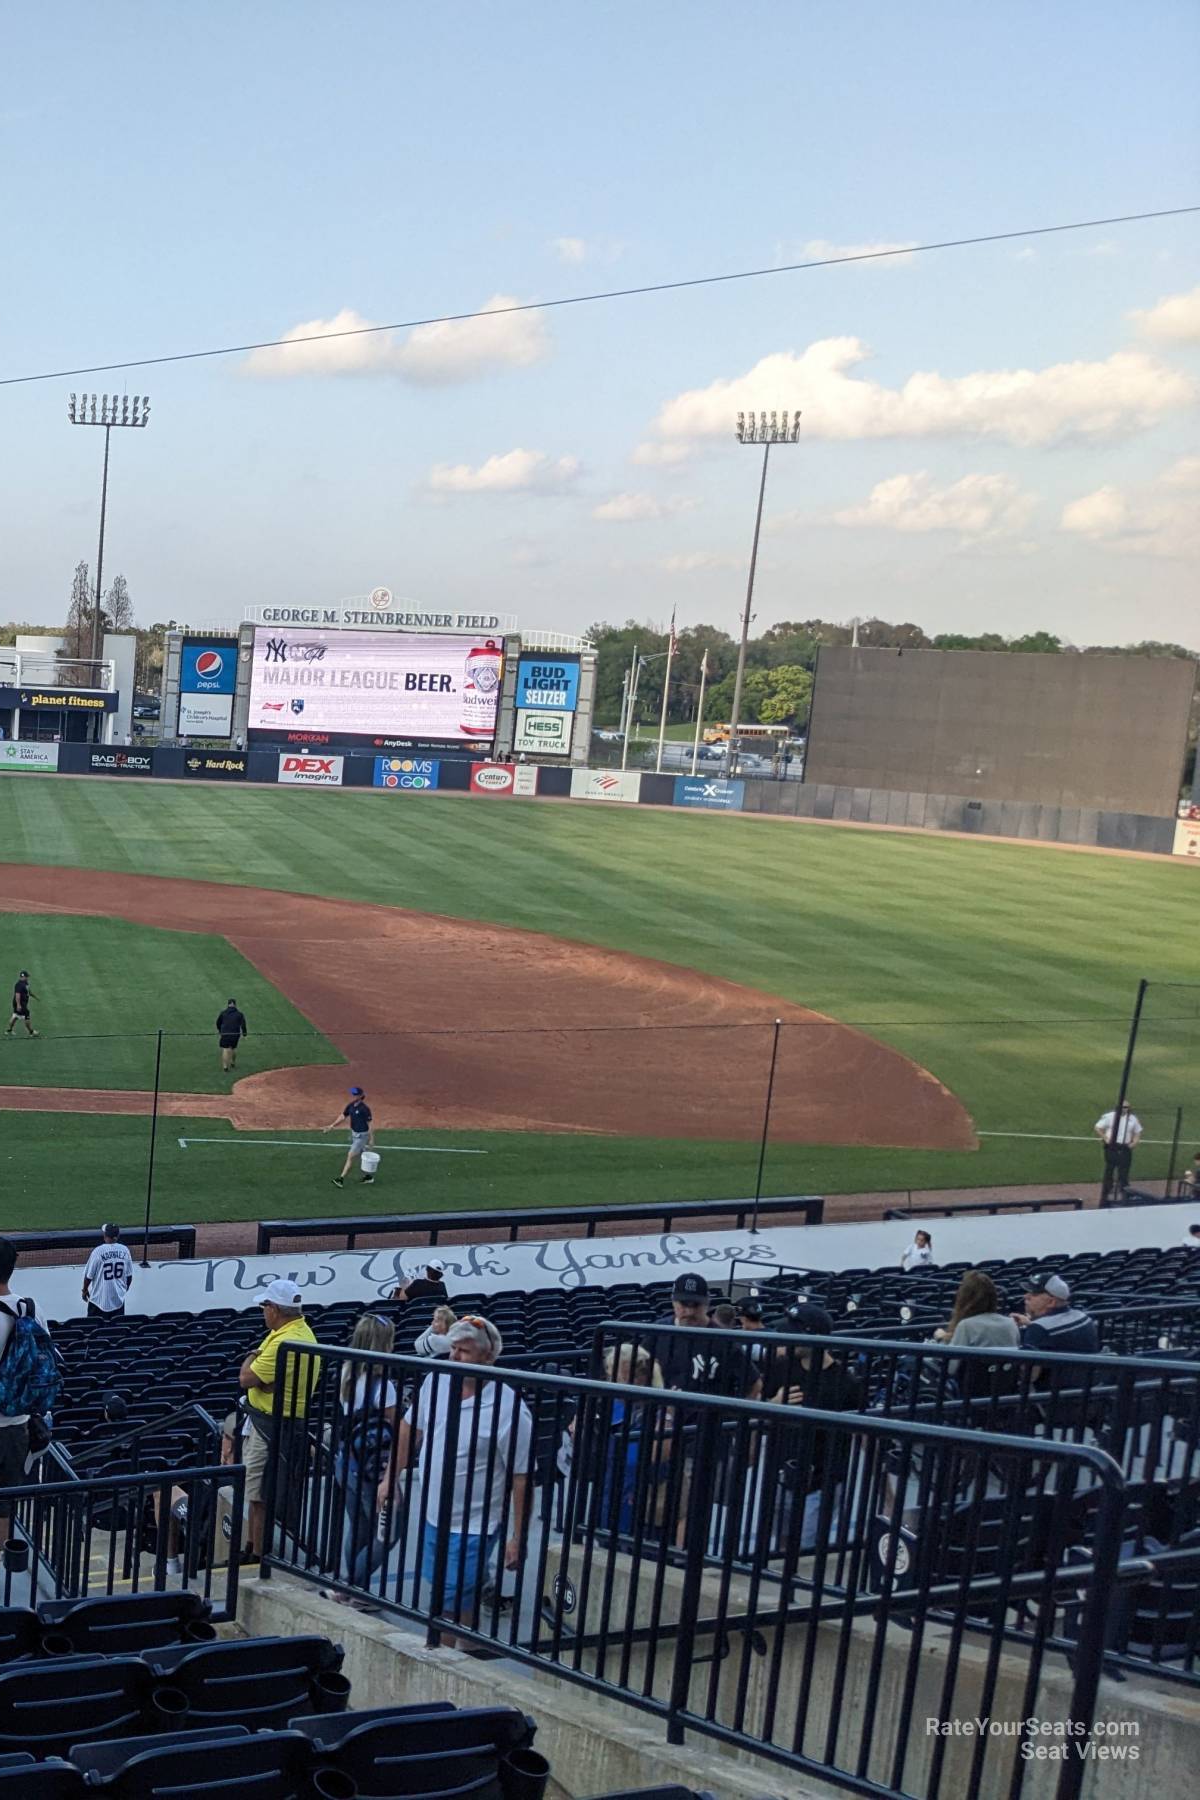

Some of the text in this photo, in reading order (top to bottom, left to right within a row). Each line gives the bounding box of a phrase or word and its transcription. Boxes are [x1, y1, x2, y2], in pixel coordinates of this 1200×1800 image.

[262, 607, 499, 629] GEORGE M. STEINBRENNER FIELD
[531, 665, 566, 679] BUD
[196, 681, 220, 690] pepsi
[263, 666, 457, 693] MAJOR LEAGUE BEER.
[523, 678, 571, 691] LIGHT
[31, 694, 104, 708] planet fitness
[525, 690, 566, 705] SELTZER
[528, 722, 560, 732] HESS
[384, 739, 412, 748] AnyDesk
[538, 740, 566, 748] TRUCK
[91, 754, 150, 765] BAD BOY
[205, 759, 225, 769] Hard
[225, 760, 244, 771] Rock
[283, 757, 335, 773] DEX
[382, 759, 432, 774] ROOMS
[294, 772, 339, 782] imaging
[381, 775, 424, 789] TO GO
[477, 772, 509, 784] Century
[158, 1258, 336, 1293] New
[503, 1234, 777, 1288] Yankees
[102, 1261, 125, 1281] 26
